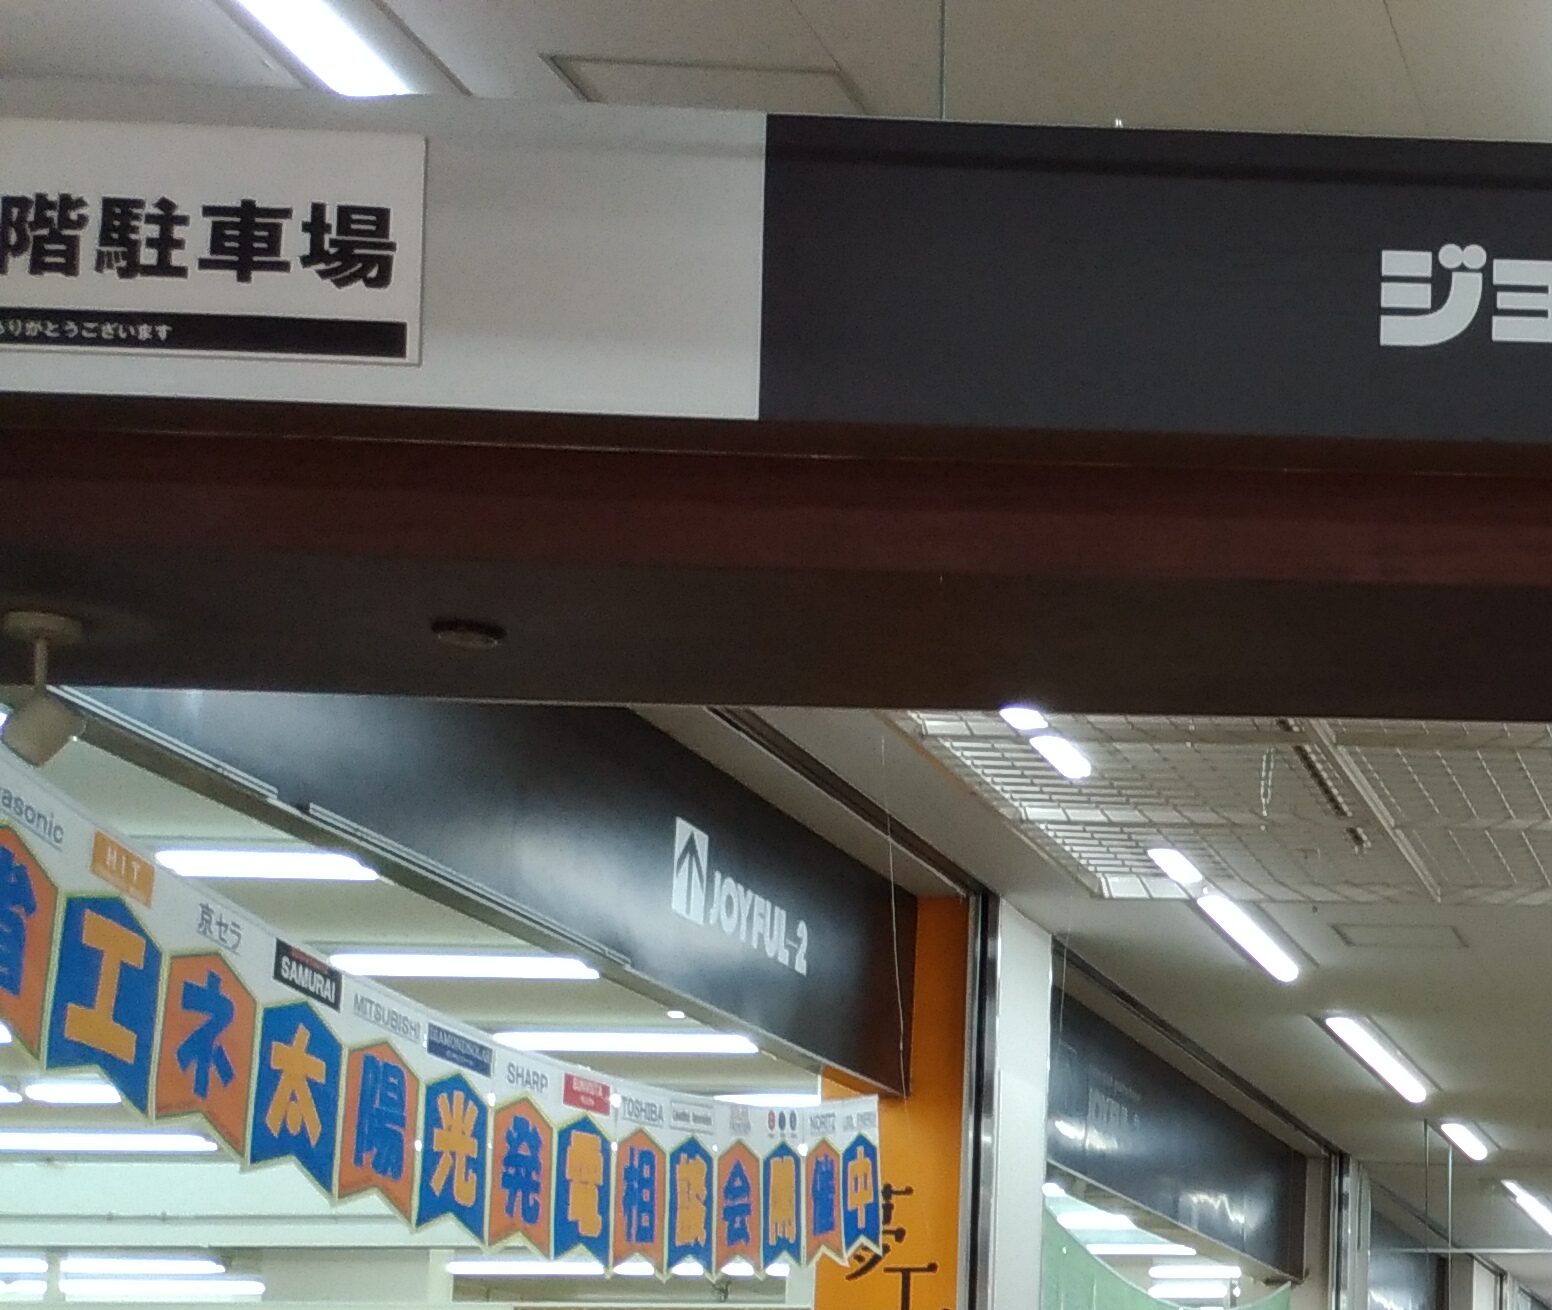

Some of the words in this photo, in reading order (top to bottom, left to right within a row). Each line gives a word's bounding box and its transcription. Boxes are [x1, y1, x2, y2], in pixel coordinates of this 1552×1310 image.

[0, 192, 397, 290] 階駐車場
[0, 786, 64, 845] asonic
[197, 903, 242, 951] 京セラ
[280, 956, 336, 1002] SAMURAI
[353, 993, 421, 1039] MITSUBISHI
[507, 1062, 549, 1094] SHARP
[622, 1095, 665, 1123] TOSHIBA
